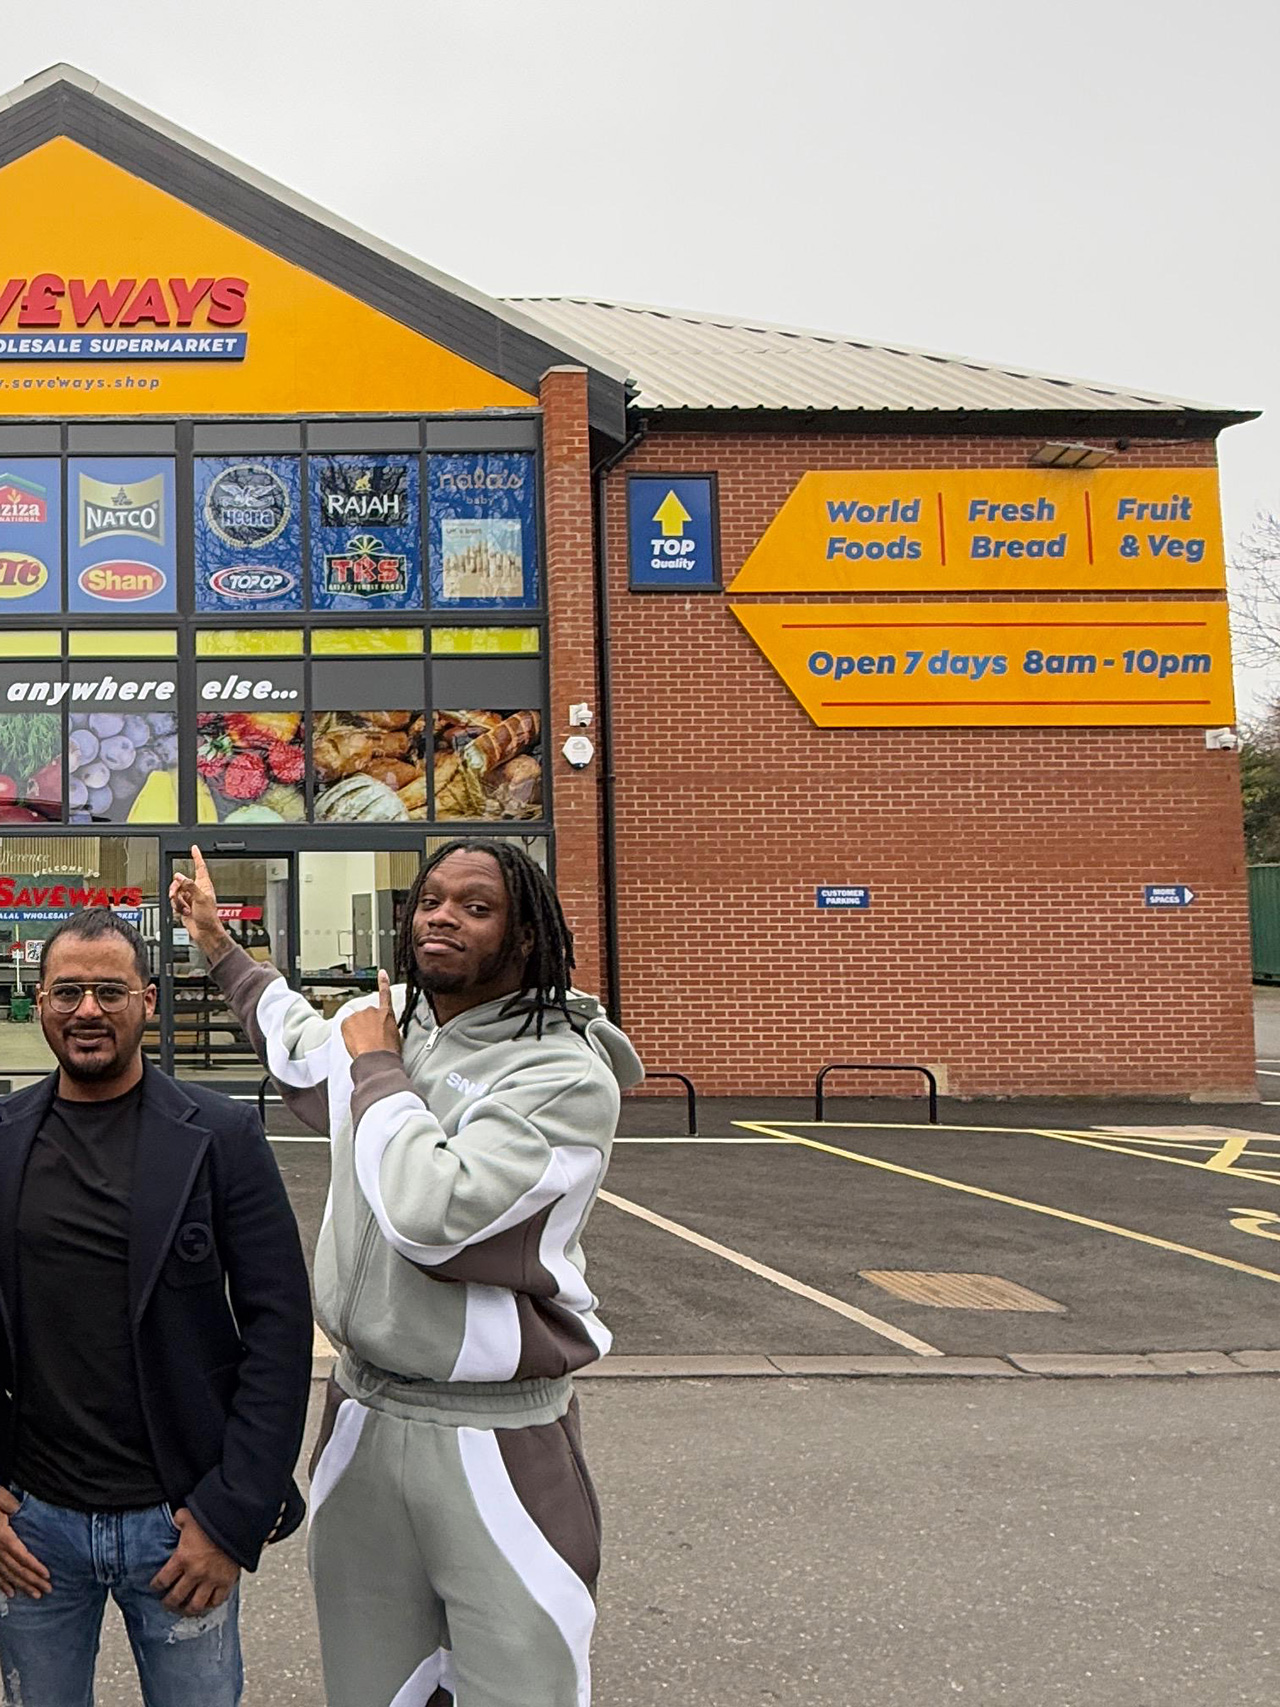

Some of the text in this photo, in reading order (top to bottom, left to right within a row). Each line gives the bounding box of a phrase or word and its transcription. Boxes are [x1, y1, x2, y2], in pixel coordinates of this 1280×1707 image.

[89, 338, 238, 353] SUPERMARKET
[328, 494, 399, 515] RAJAH
[826, 498, 920, 524] World
[967, 497, 1055, 523] Fresh
[1116, 495, 1192, 522] Fruit
[86, 507, 156, 530] NATCO
[650, 538, 695, 556] TOP
[826, 535, 922, 561] Foods
[970, 533, 1066, 559] Bread
[1119, 533, 1205, 563] & Veg
[331, 554, 400, 583] TRS
[650, 558, 695, 571] Quality
[88, 570, 152, 590] Shan
[808, 651, 897, 679] Open
[903, 651, 924, 675] 7
[928, 649, 1007, 679] days
[1023, 650, 1097, 675] 8am
[1123, 650, 1212, 679] 10pm
[6, 676, 176, 706] anywhere
[200, 675, 298, 700] else...
[33, 864, 100, 878] WELCOME TO
[217, 909, 242, 917] EXIT
